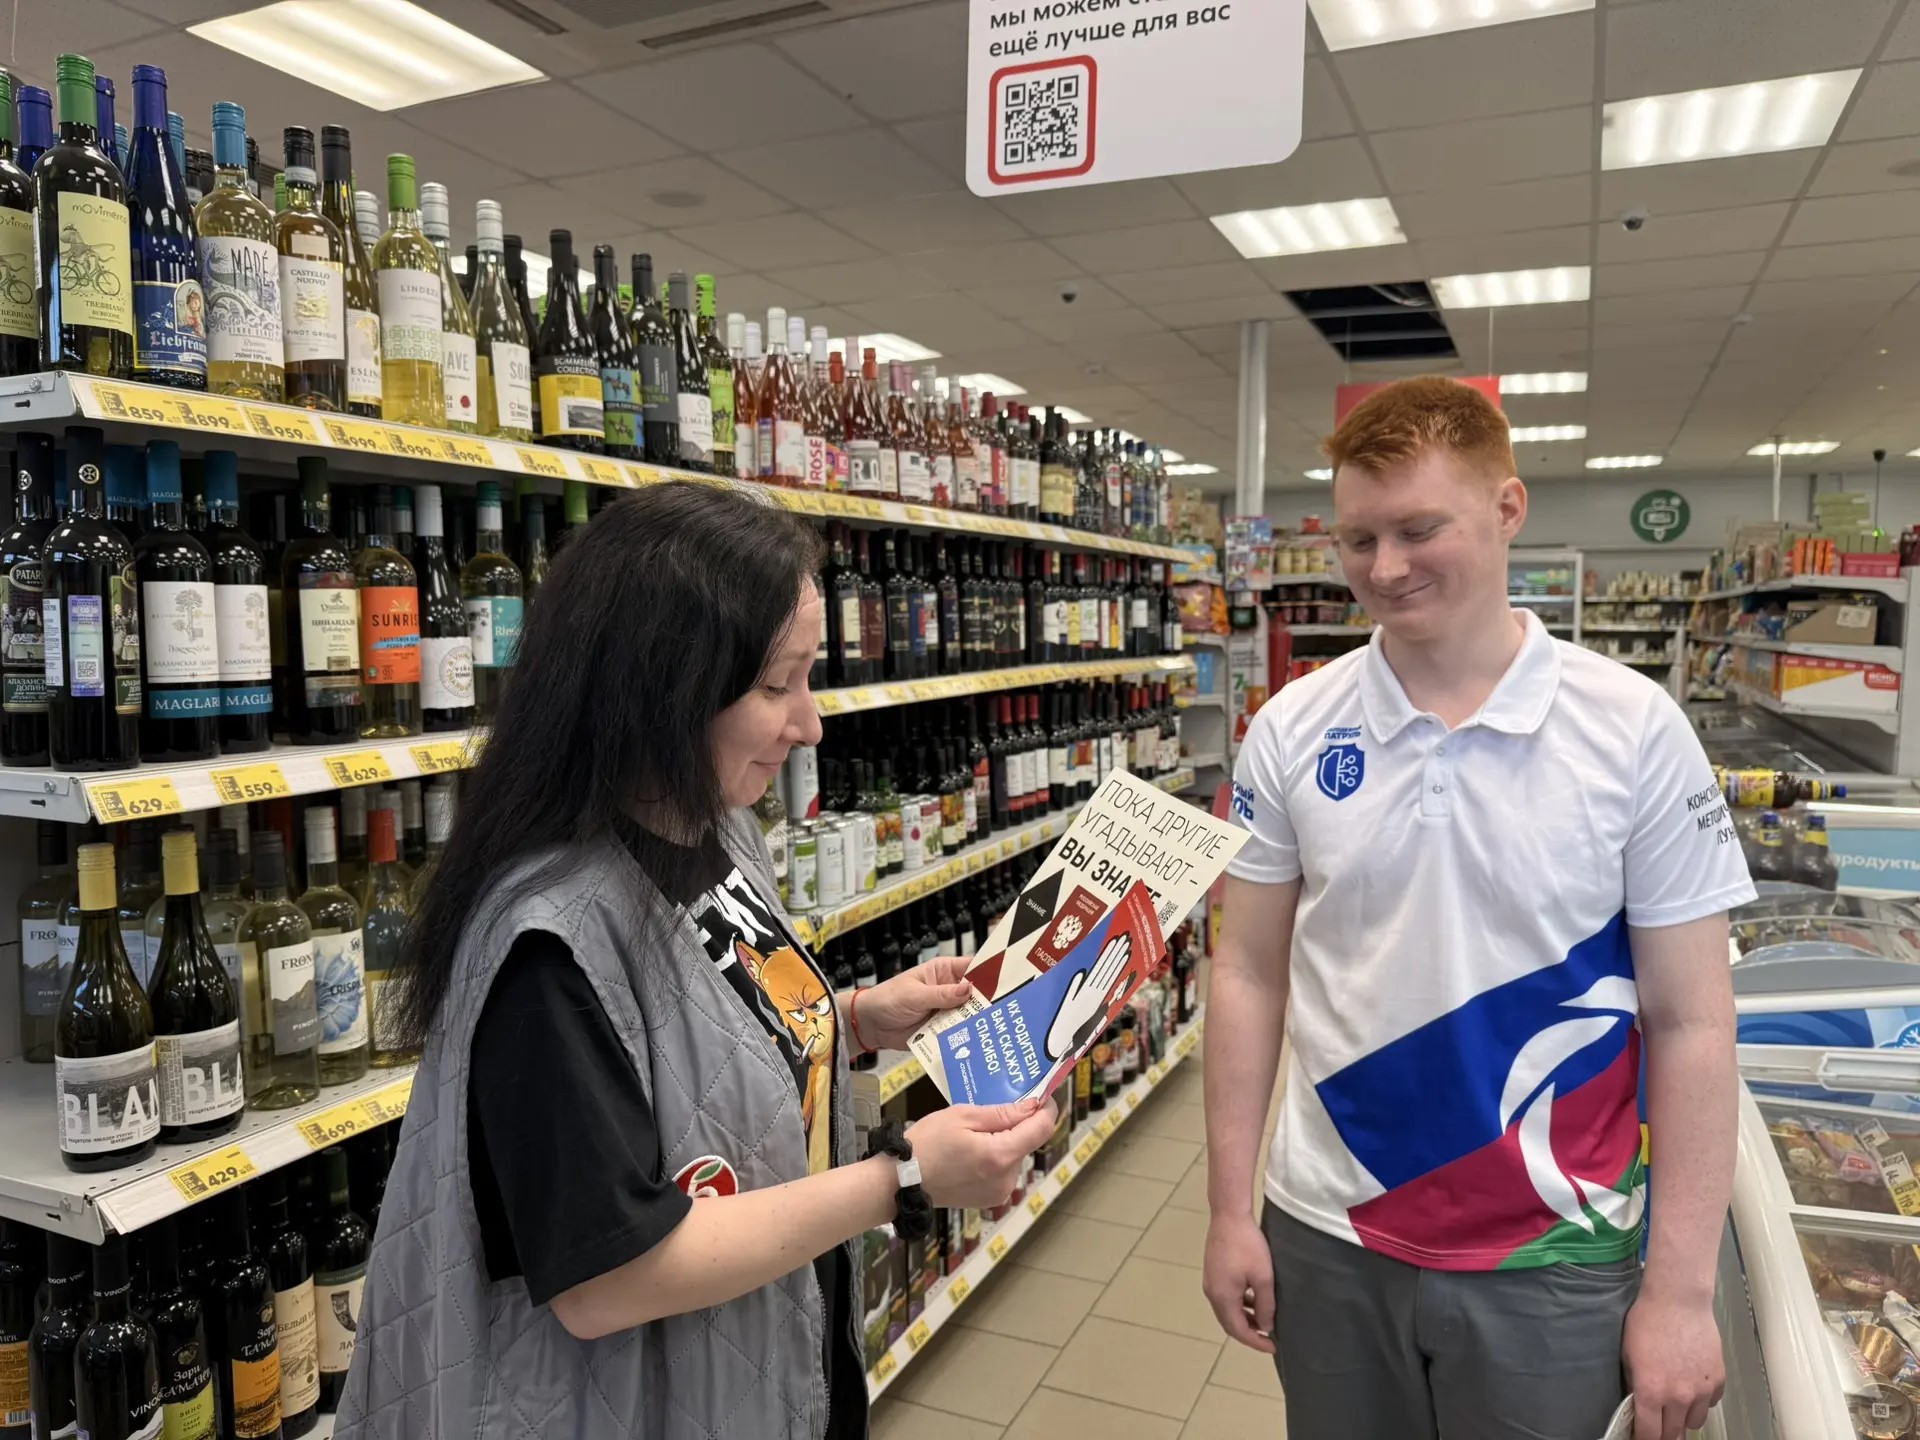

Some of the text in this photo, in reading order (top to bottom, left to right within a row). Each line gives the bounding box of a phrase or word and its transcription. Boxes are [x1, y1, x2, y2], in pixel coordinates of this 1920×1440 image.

[990, 10, 1025, 29] мы
[989, 4, 1231, 57] ещё лучше для вас
[290, 268, 331, 280] CASTELLO
[296, 277, 326, 287] NUOVO
[129, 406, 165, 421] 859
[196, 414, 230, 429] 899
[274, 425, 304, 440] 959
[350, 436, 377, 449] 999
[406, 444, 433, 458] 999
[459, 451, 483, 464] 999
[436, 754, 461, 770] 799
[353, 767, 379, 782] 629
[244, 782, 274, 799] 559
[129, 798, 163, 815] 629
[1100, 779, 1229, 861] ПОКА ДРУГИЕ
[1058, 837, 1096, 872] ВЫ
[1080, 807, 1194, 886] УГАДЫВАЮТ
[1025, 898, 1048, 918] ЗНАНИЕ
[975, 1017, 1001, 1076] СПАСИБО!
[991, 1007, 1025, 1084] ВАМ СКАЖУТ
[1006, 999, 1042, 1080] ИХ РОДИТЕЛИ
[327, 1120, 357, 1139] 699
[207, 1166, 239, 1188] 429
